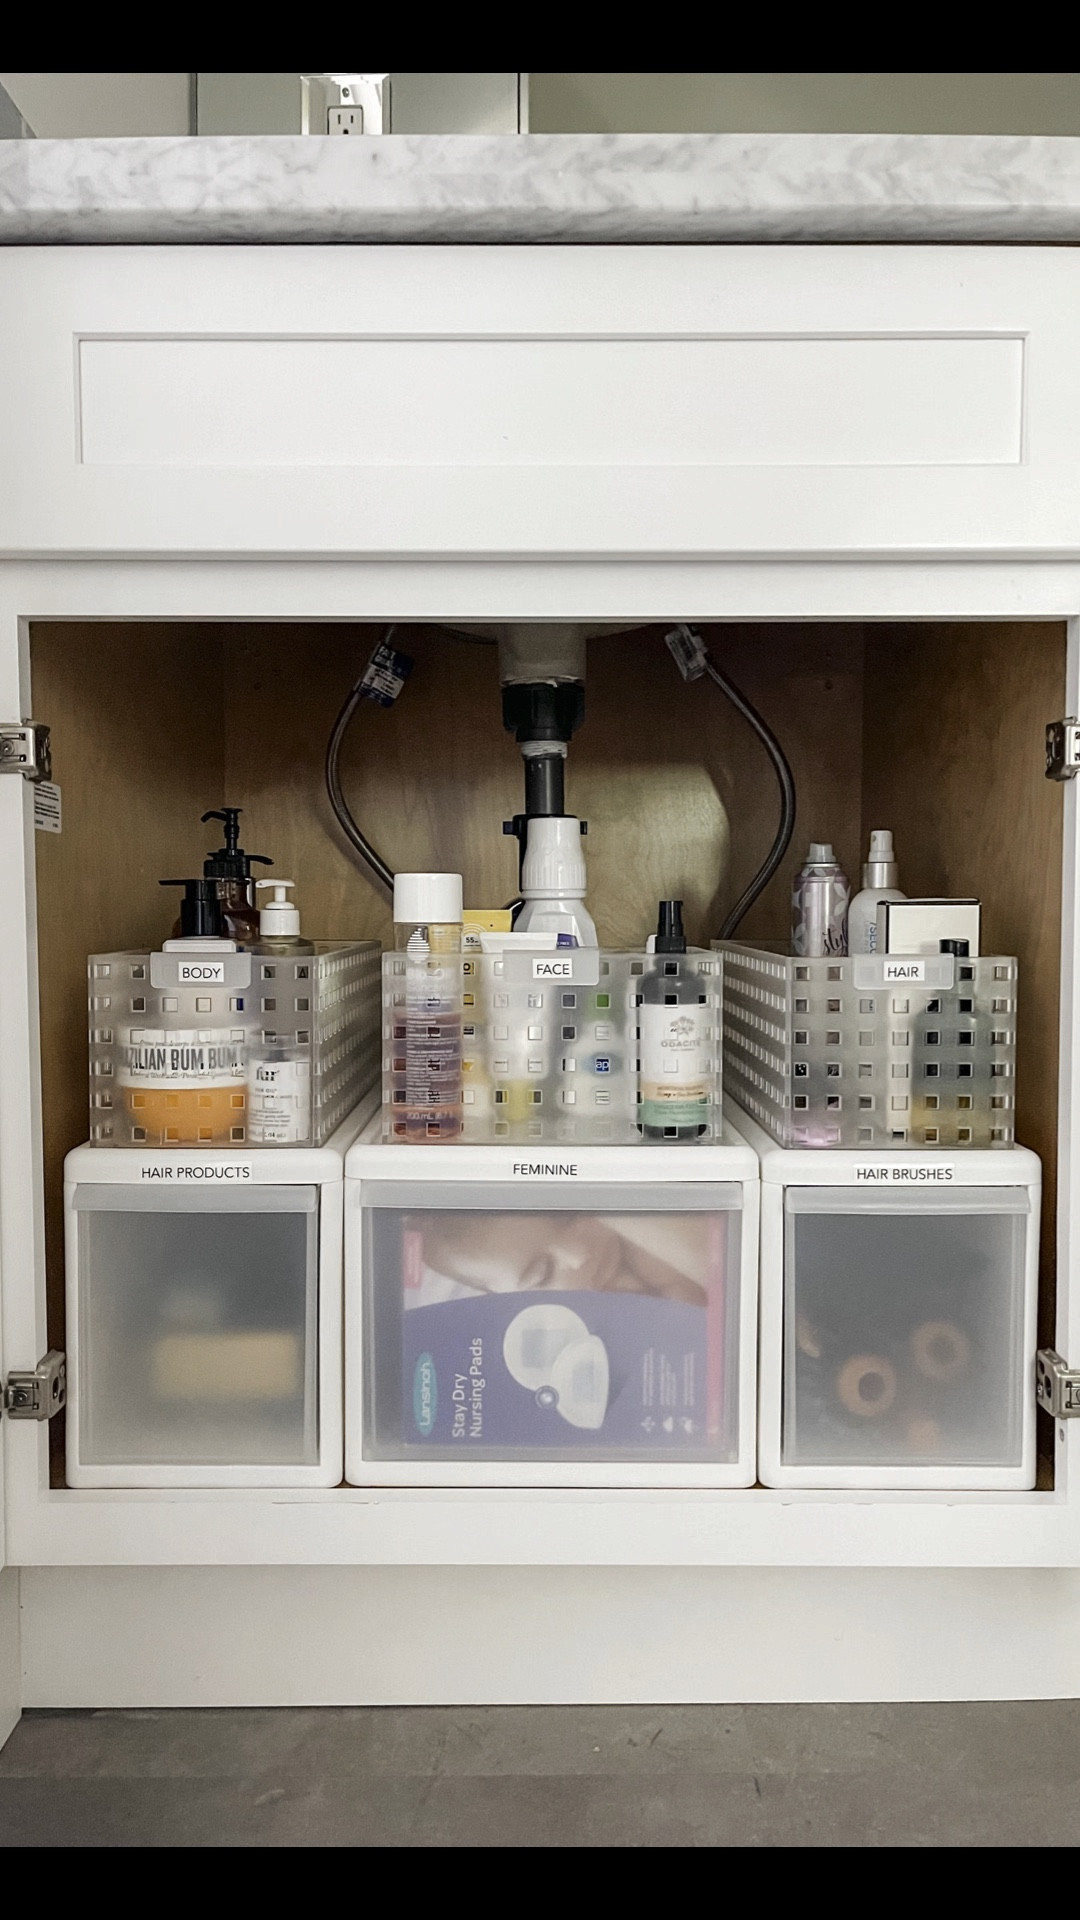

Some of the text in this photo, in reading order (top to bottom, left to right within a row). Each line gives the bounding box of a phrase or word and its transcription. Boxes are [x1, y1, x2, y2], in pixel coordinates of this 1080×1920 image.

[182, 967, 221, 979] BODY
[536, 963, 570, 976] FACE
[887, 966, 919, 978] HAIR
[171, 1048, 204, 1071] BUM
[141, 1166, 250, 1179] HAIR PRODUCTS
[513, 1163, 578, 1176] FEMININE
[857, 1168, 953, 1180] HAIR BRUSHES
[419, 1361, 431, 1426] Lansinoh
[469, 1337, 486, 1438] Nursing Pads
[452, 1373, 468, 1438] Stay Dry
